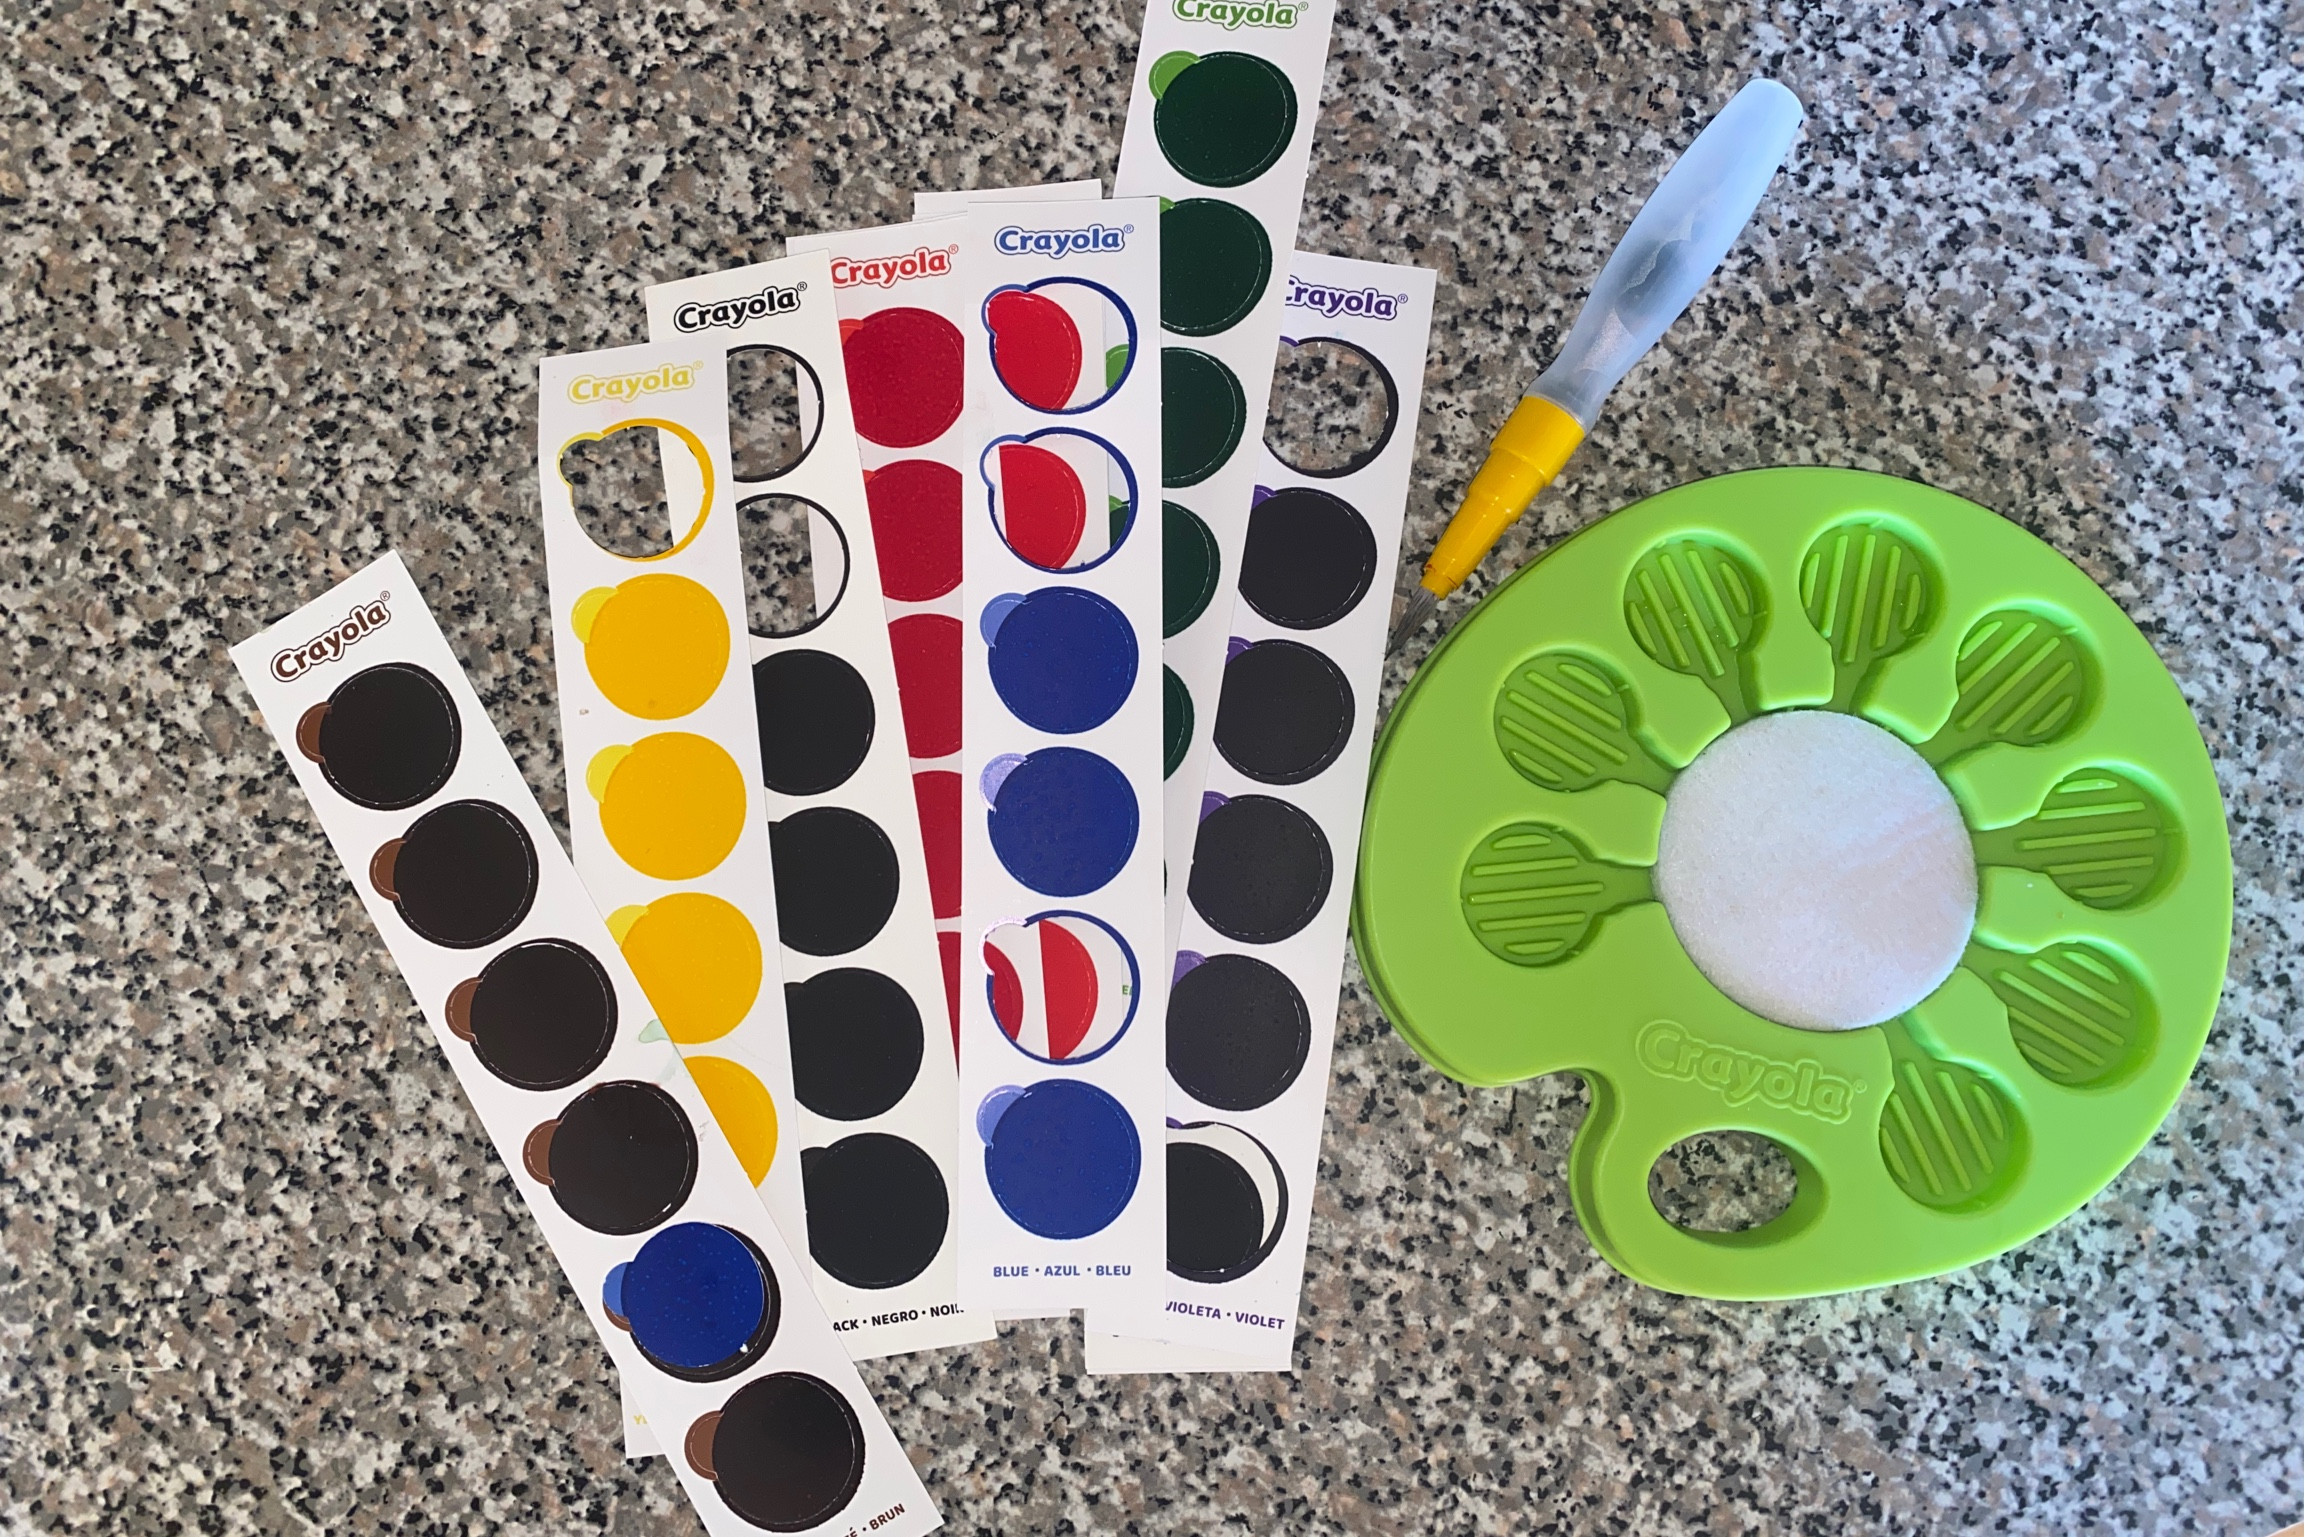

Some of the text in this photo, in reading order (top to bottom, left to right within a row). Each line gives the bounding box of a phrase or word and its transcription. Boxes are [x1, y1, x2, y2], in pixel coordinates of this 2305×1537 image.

[1175, 0, 1295, 28] Crayola
[997, 226, 1122, 257] Crayola
[830, 249, 949, 286] Crayola
[676, 288, 797, 330] Crayola
[570, 365, 691, 401] Crayola
[274, 603, 388, 680] Crayola
[1642, 1025, 1847, 1117] Crayola
[993, 1264, 1131, 1277] BLUE AZUL BLEU
[833, 1318, 860, 1332] ACK
[871, 1309, 919, 1327] NEGRO
[1165, 1301, 1285, 1330] VIOLETA VIOLET
[868, 1503, 906, 1531] BRUN
